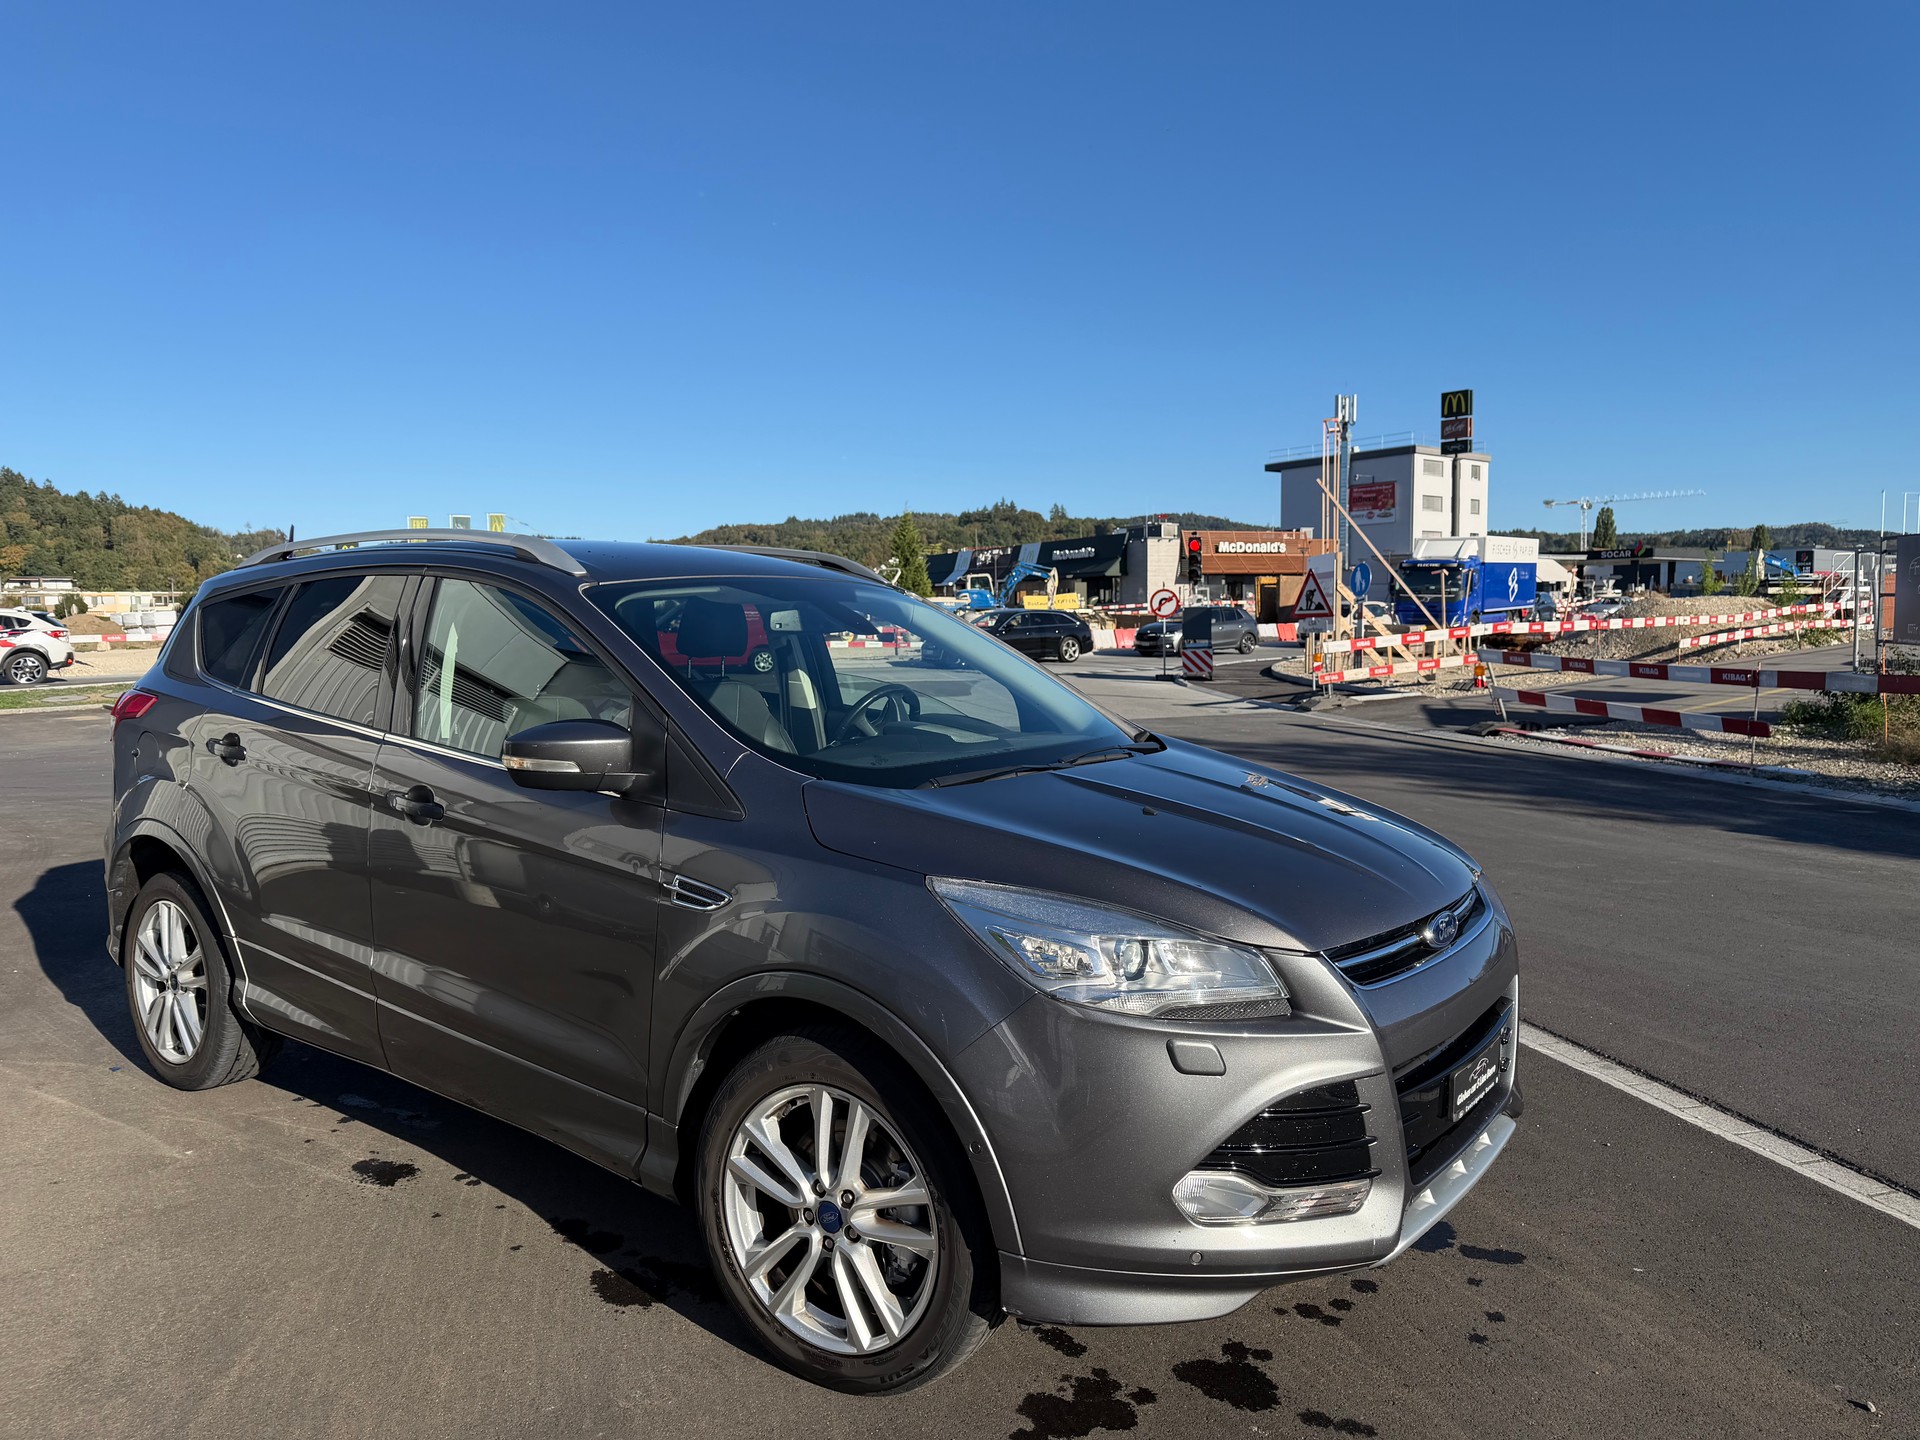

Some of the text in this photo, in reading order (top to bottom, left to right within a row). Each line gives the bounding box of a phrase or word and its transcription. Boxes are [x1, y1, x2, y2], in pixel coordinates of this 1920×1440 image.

[1218, 541, 1287, 553] McDonald's
[1600, 550, 1632, 559] SOCAR
[1638, 665, 1660, 675] KIBAG
[1722, 672, 1746, 682] KIBAG
[1438, 916, 1456, 941] Ford
[822, 1212, 838, 1223] Ford
